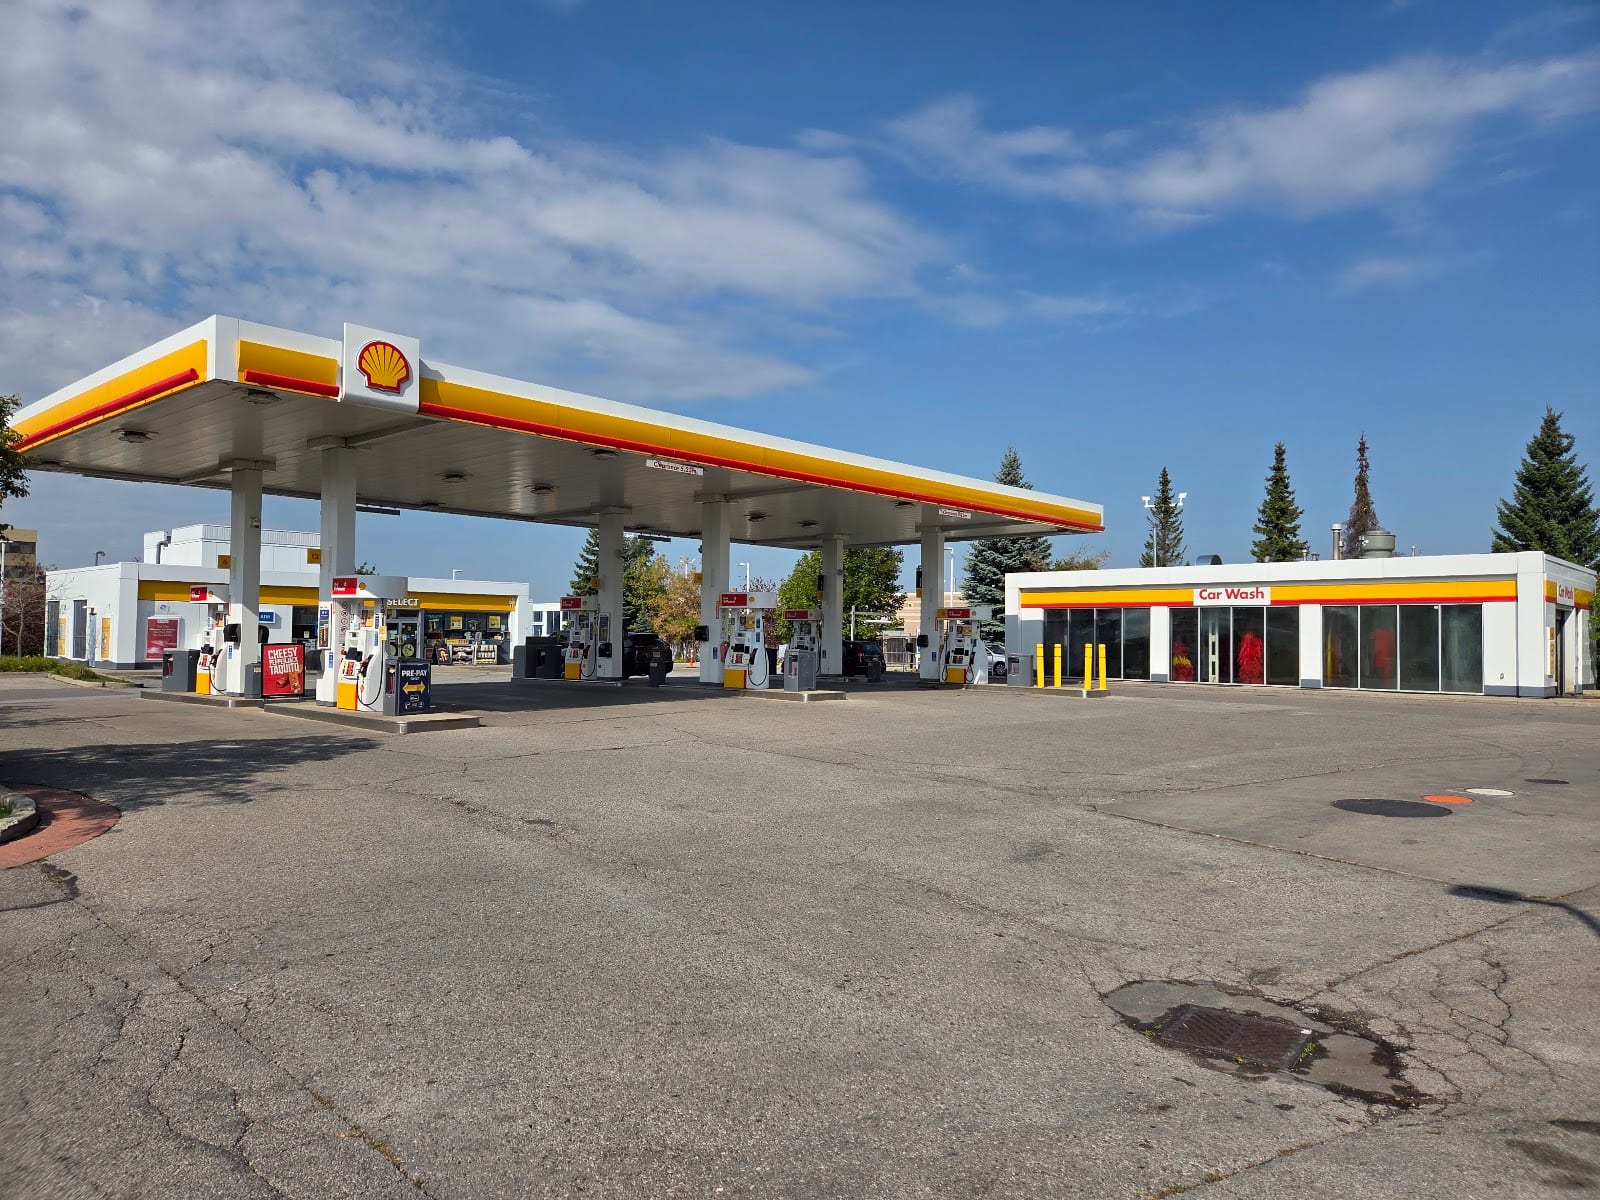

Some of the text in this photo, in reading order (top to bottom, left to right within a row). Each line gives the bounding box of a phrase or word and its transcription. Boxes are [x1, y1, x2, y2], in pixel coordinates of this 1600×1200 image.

[1198, 586, 1265, 600] Car Wash
[386, 598, 419, 606] SELECT
[267, 646, 298, 660] CHEESY
[269, 662, 300, 676] TAQUITO
[401, 669, 428, 677] PRE-PAY
